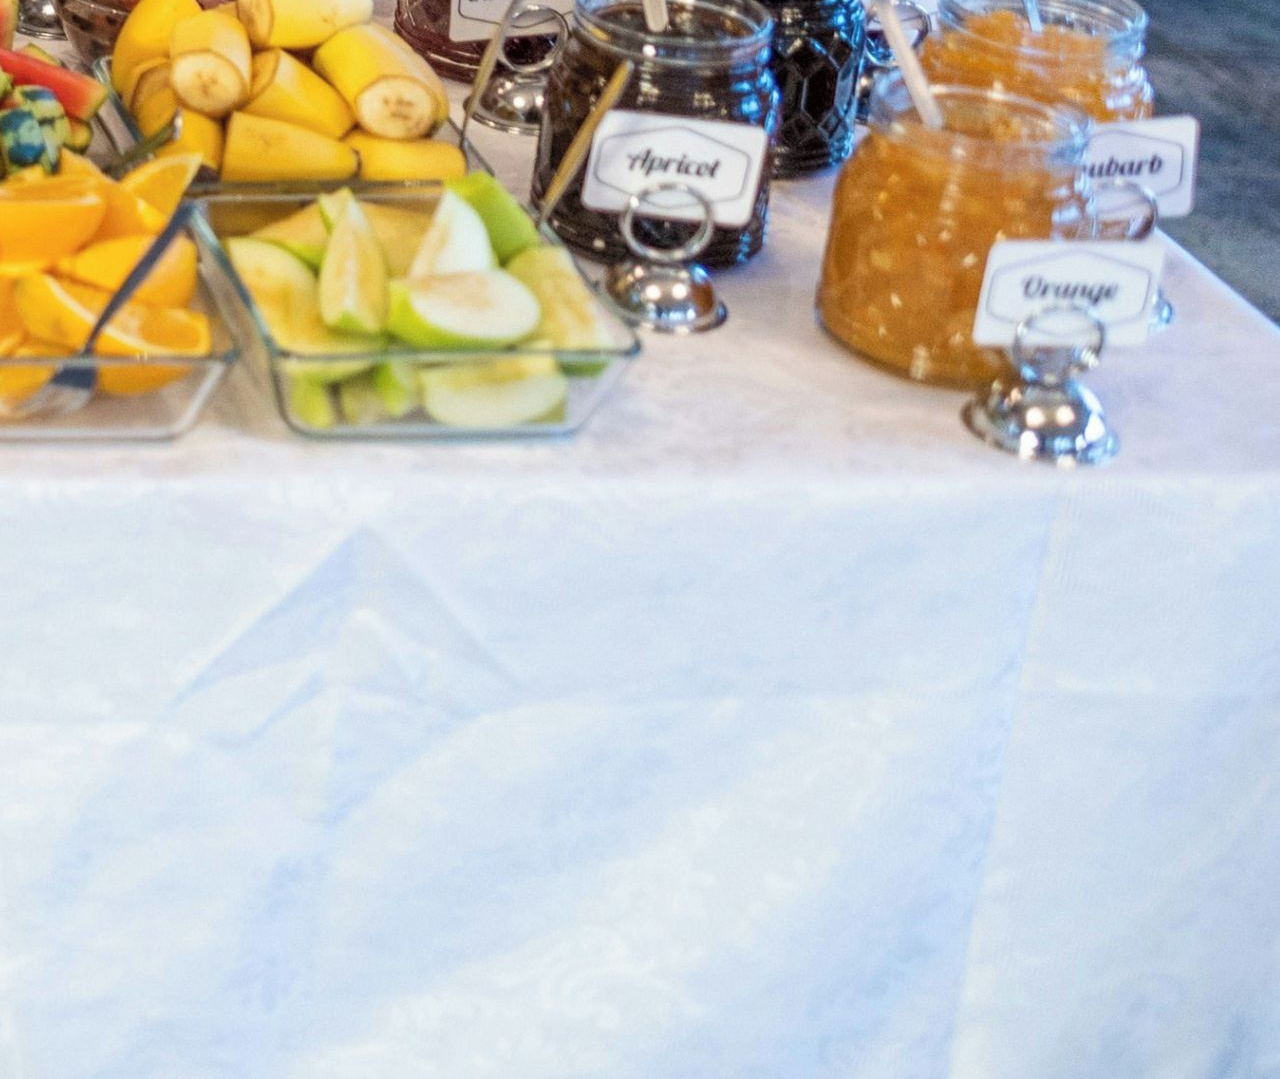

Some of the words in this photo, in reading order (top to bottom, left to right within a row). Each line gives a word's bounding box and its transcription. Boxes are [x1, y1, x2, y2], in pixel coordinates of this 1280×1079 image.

[626, 149, 721, 178] Apricot
[1084, 154, 1163, 178] ubarb
[1022, 276, 1120, 306] Orange
